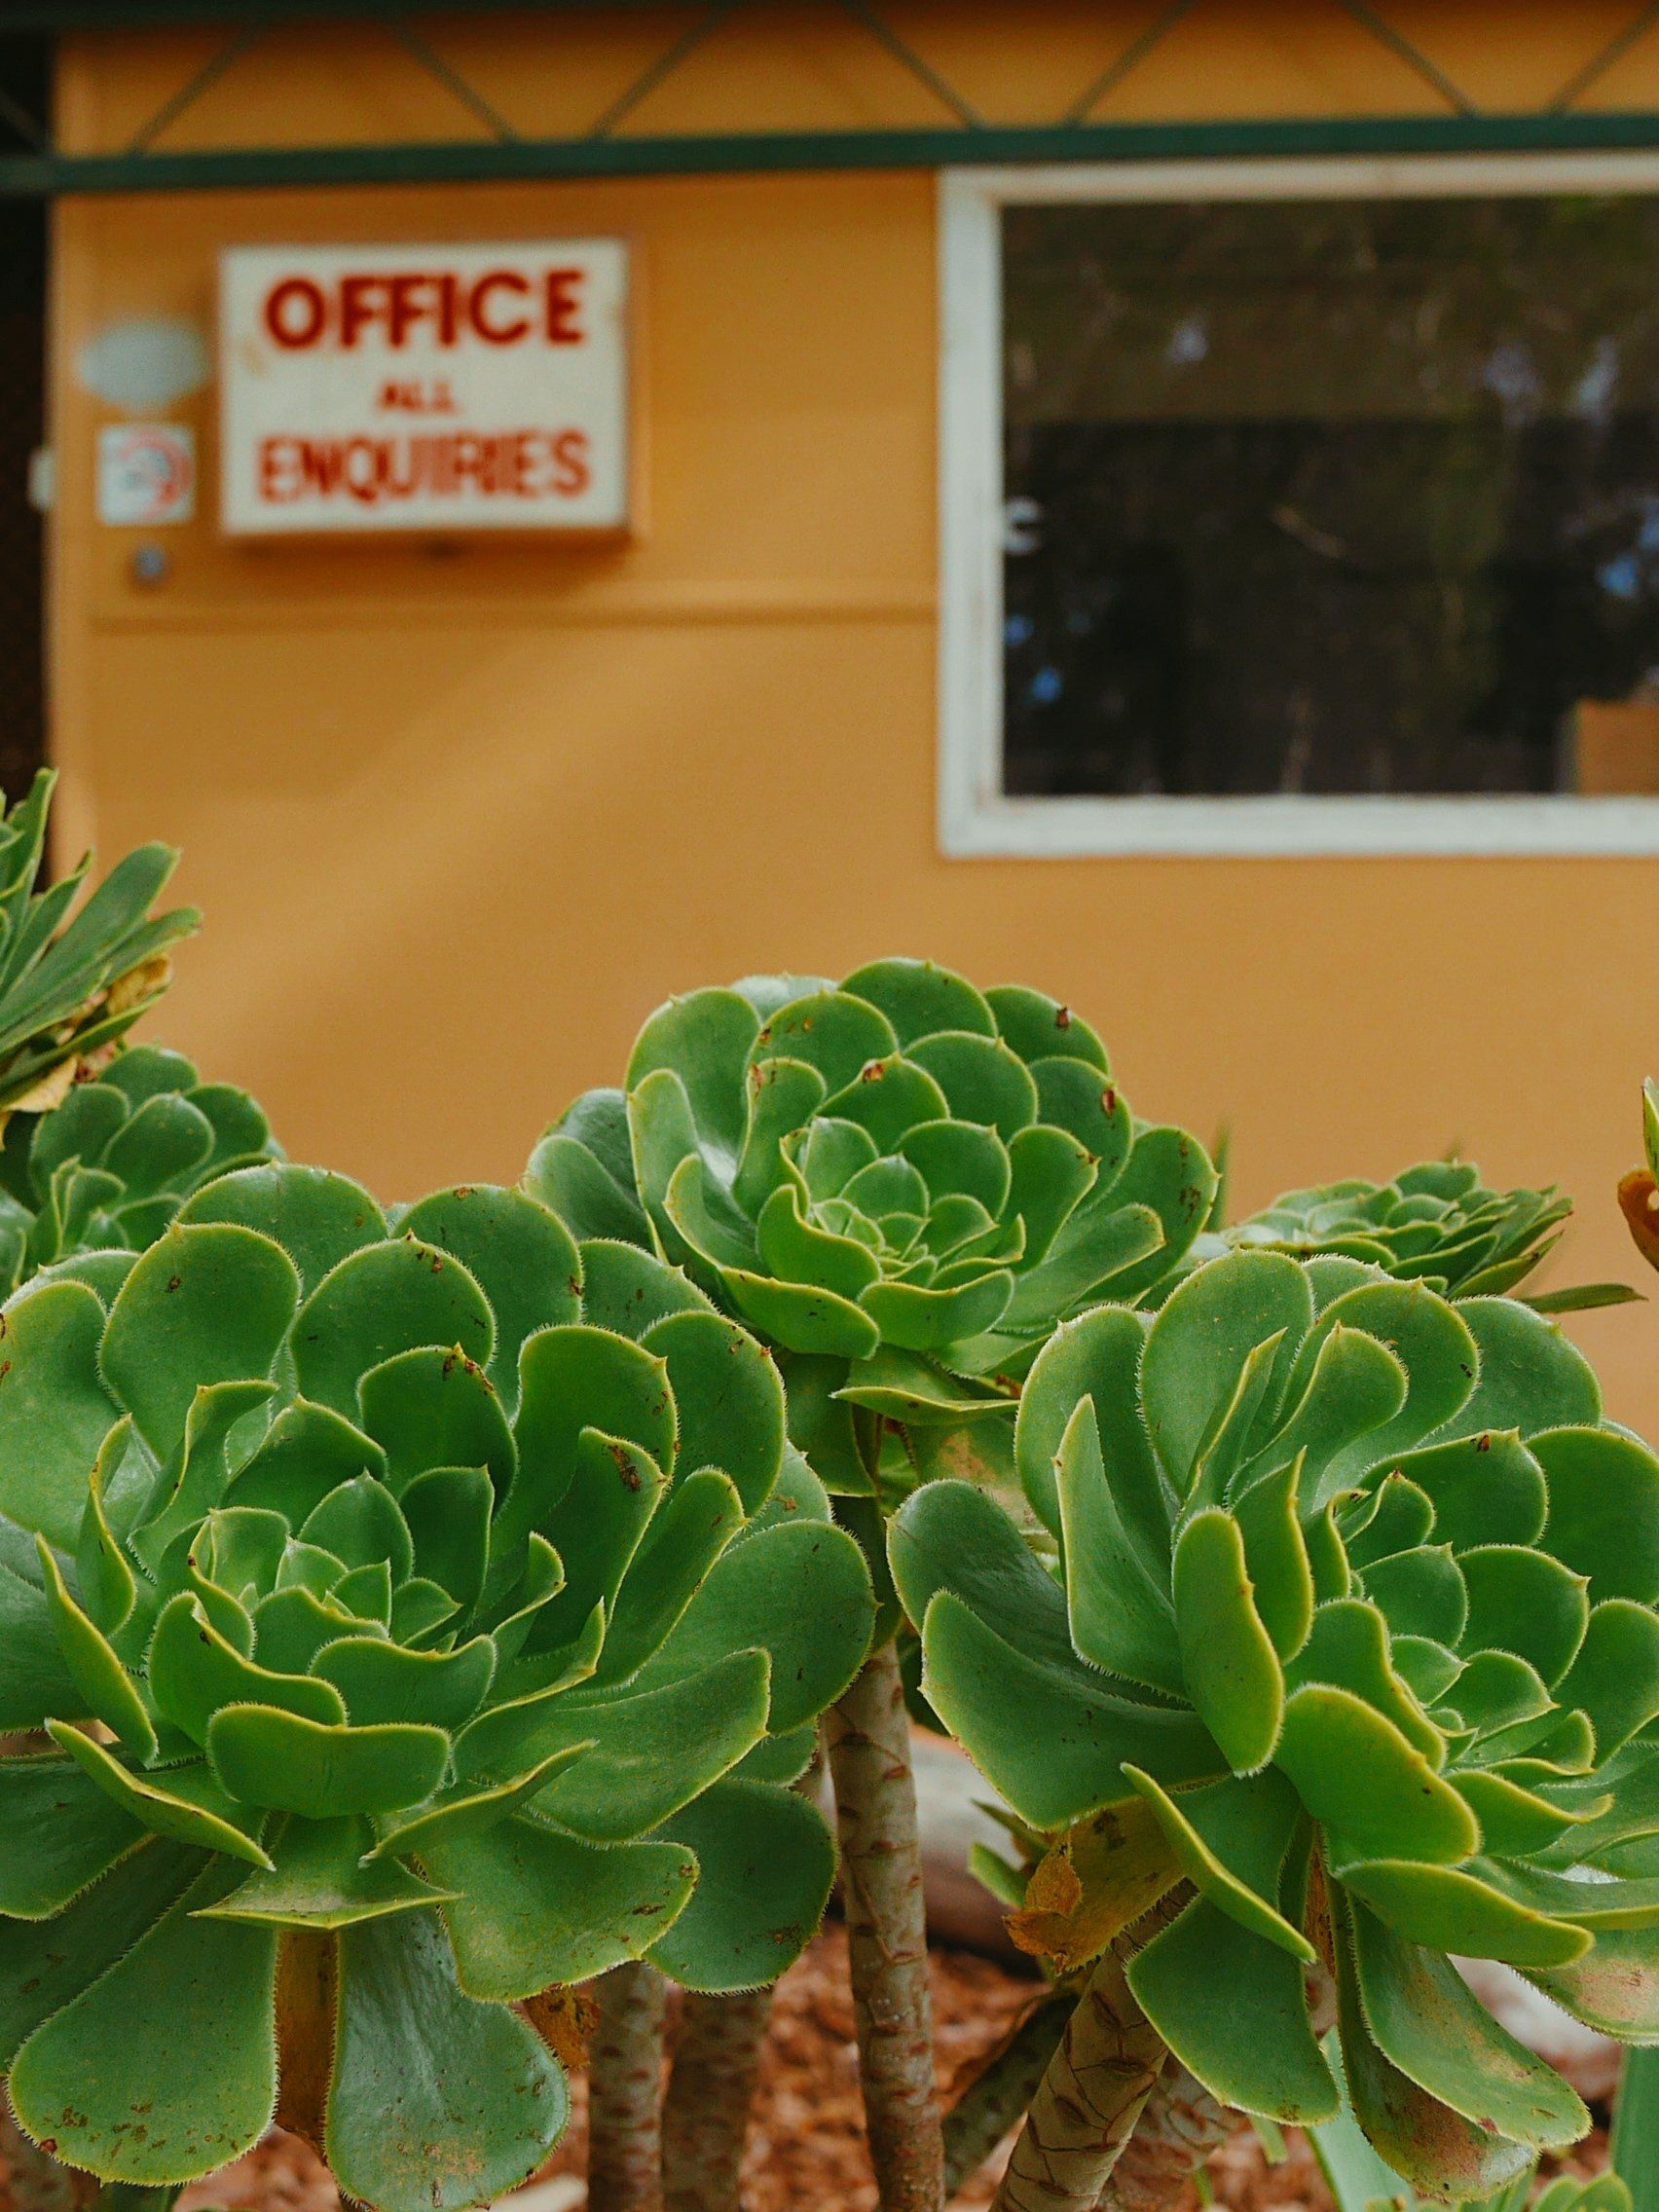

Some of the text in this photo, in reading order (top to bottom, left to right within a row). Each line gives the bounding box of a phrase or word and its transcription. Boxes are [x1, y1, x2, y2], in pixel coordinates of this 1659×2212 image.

[262, 266, 585, 350] OFFICE
[376, 380, 458, 414] ALL
[258, 428, 590, 506] ENQUIRIES
